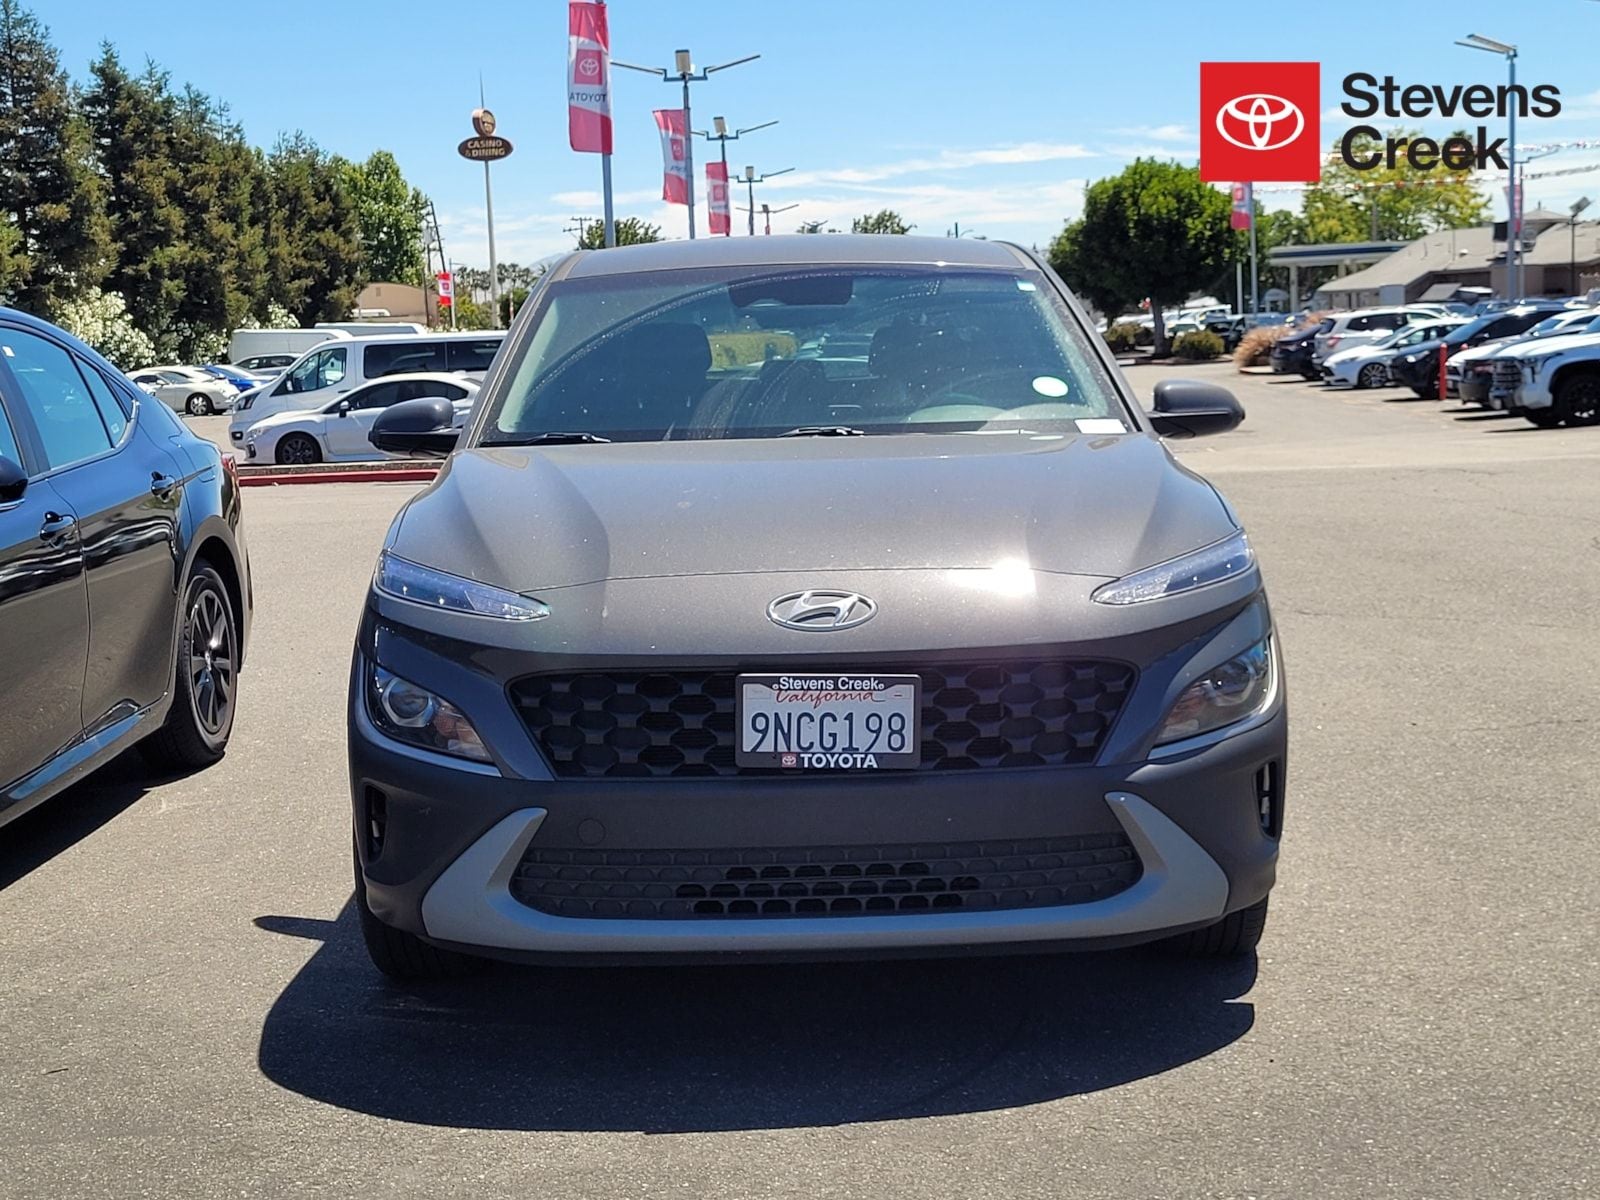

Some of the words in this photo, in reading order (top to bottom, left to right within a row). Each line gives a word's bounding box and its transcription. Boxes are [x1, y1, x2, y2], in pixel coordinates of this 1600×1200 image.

[467, 140, 502, 149] CASINO
[471, 148, 506, 157] DINING
[780, 677, 834, 690] Stevens
[838, 677, 879, 690] Creek
[751, 712, 906, 752] 9NCG198
[800, 754, 878, 769] TOYOTA
